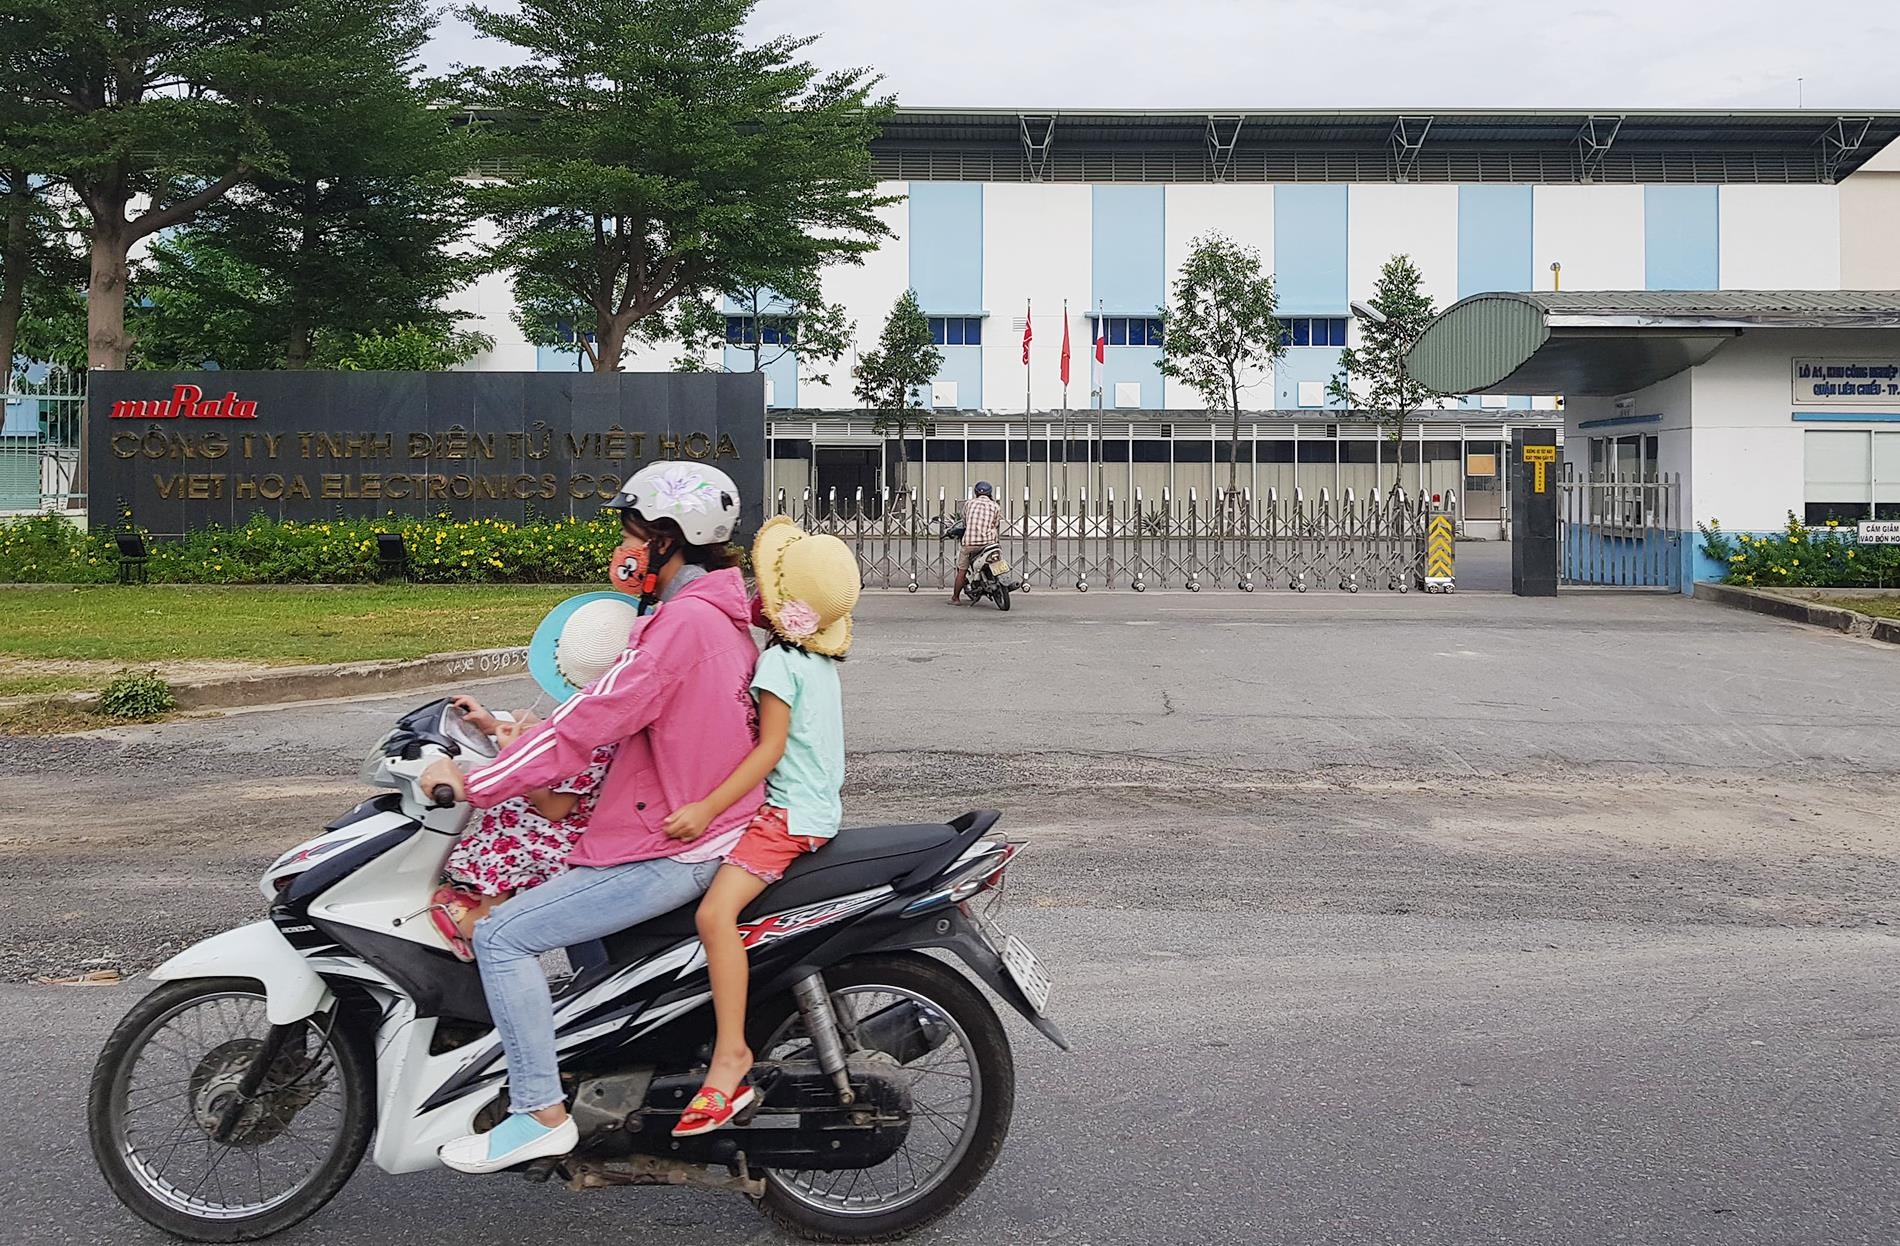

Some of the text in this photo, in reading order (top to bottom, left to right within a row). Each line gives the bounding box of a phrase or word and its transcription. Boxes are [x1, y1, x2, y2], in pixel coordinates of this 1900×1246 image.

[111, 420, 740, 467] CÔNG TY TNHH ĐIỆN TỬ VIỆT HOA
[153, 473, 226, 499] VIET
[236, 473, 311, 499] HOA
[321, 473, 556, 499] ELECTRONICS
